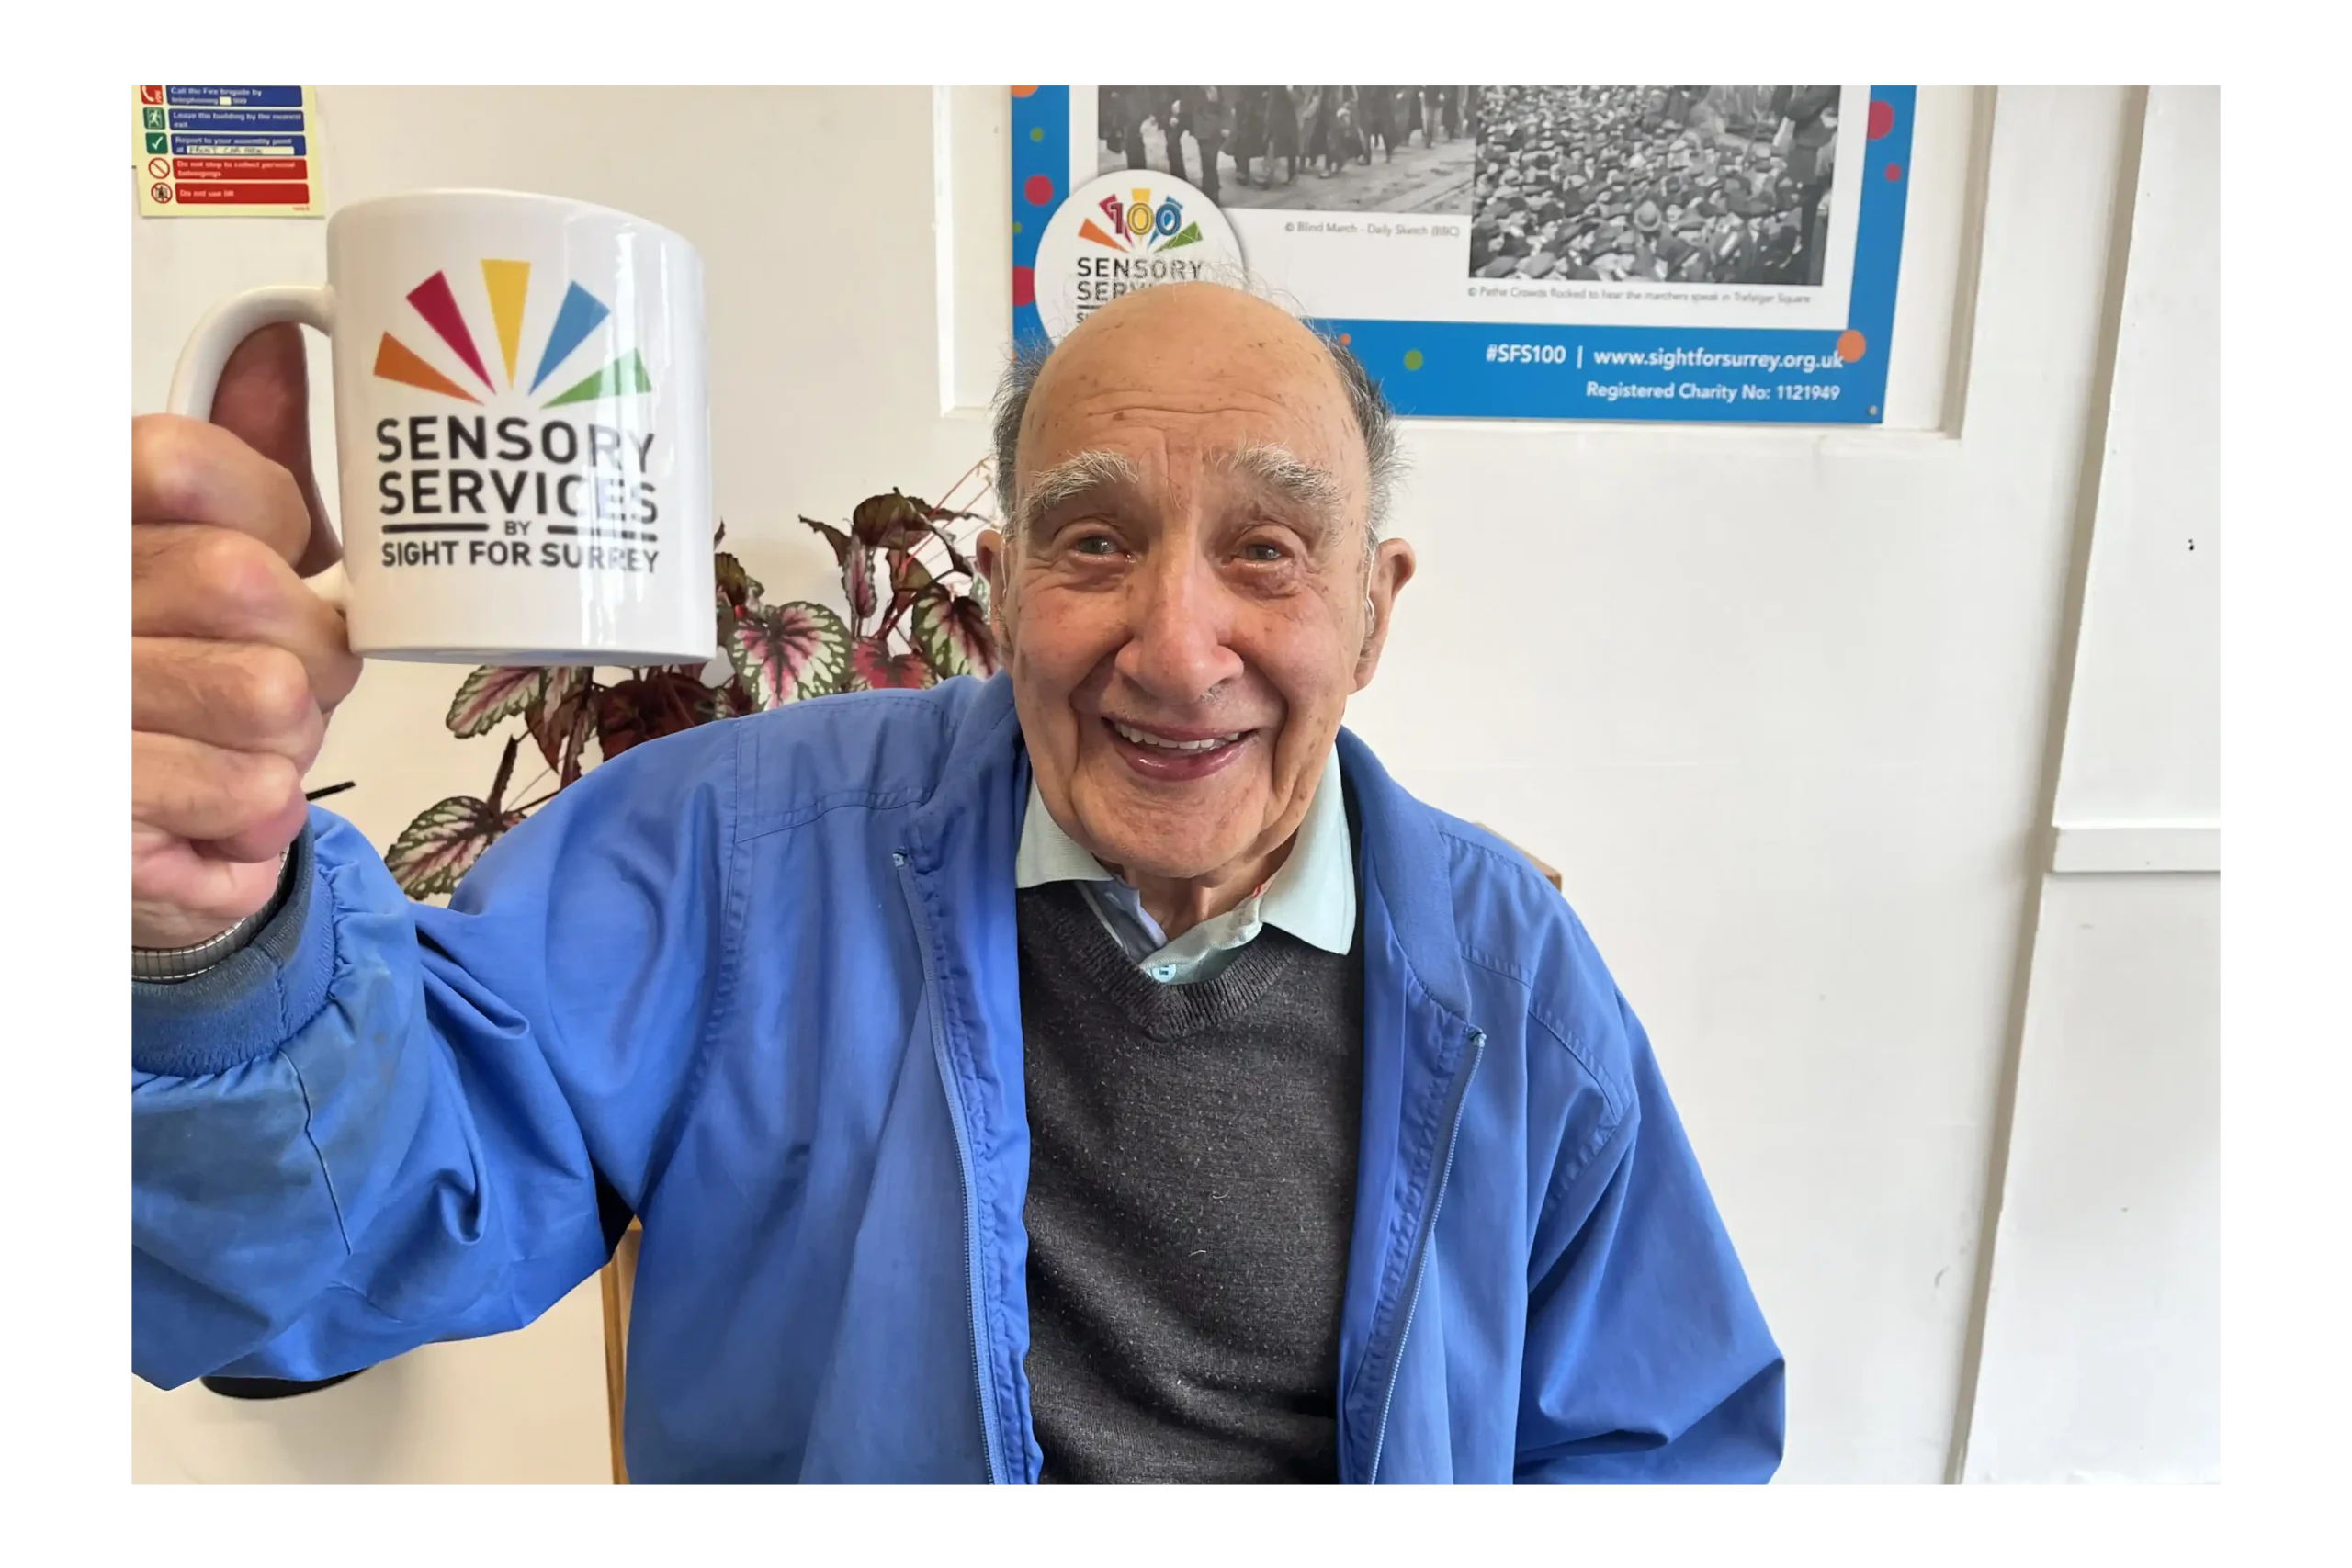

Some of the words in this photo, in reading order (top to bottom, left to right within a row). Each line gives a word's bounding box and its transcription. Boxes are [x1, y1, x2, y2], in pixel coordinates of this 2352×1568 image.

[252, 88, 262, 96] by
[213, 112, 245, 121] building
[246, 113, 256, 121] by
[175, 136, 202, 144] Report
[205, 161, 222, 169] stop
[261, 161, 295, 169] personal
[1110, 202, 1182, 236] 100
[1297, 221, 1323, 232] Blind
[1326, 222, 1358, 233] March
[1367, 223, 1393, 237] Daily
[1077, 256, 1203, 280] SENSORY
[1589, 289, 1600, 299] to
[1486, 344, 1566, 364] #SFS100
[1593, 346, 1844, 373] www.sightforsurrey.org.uk
[1586, 380, 1676, 401] Registered
[1679, 382, 1737, 403] Charity
[1742, 384, 1771, 400] No:
[1777, 384, 1841, 400] 1121949
[376, 415, 655, 473] SENSORY
[379, 468, 659, 525] SERVICES
[504, 520, 532, 536] BY
[381, 540, 459, 568] SIGHT
[469, 540, 532, 567] FOR
[539, 541, 660, 574] SURREY
